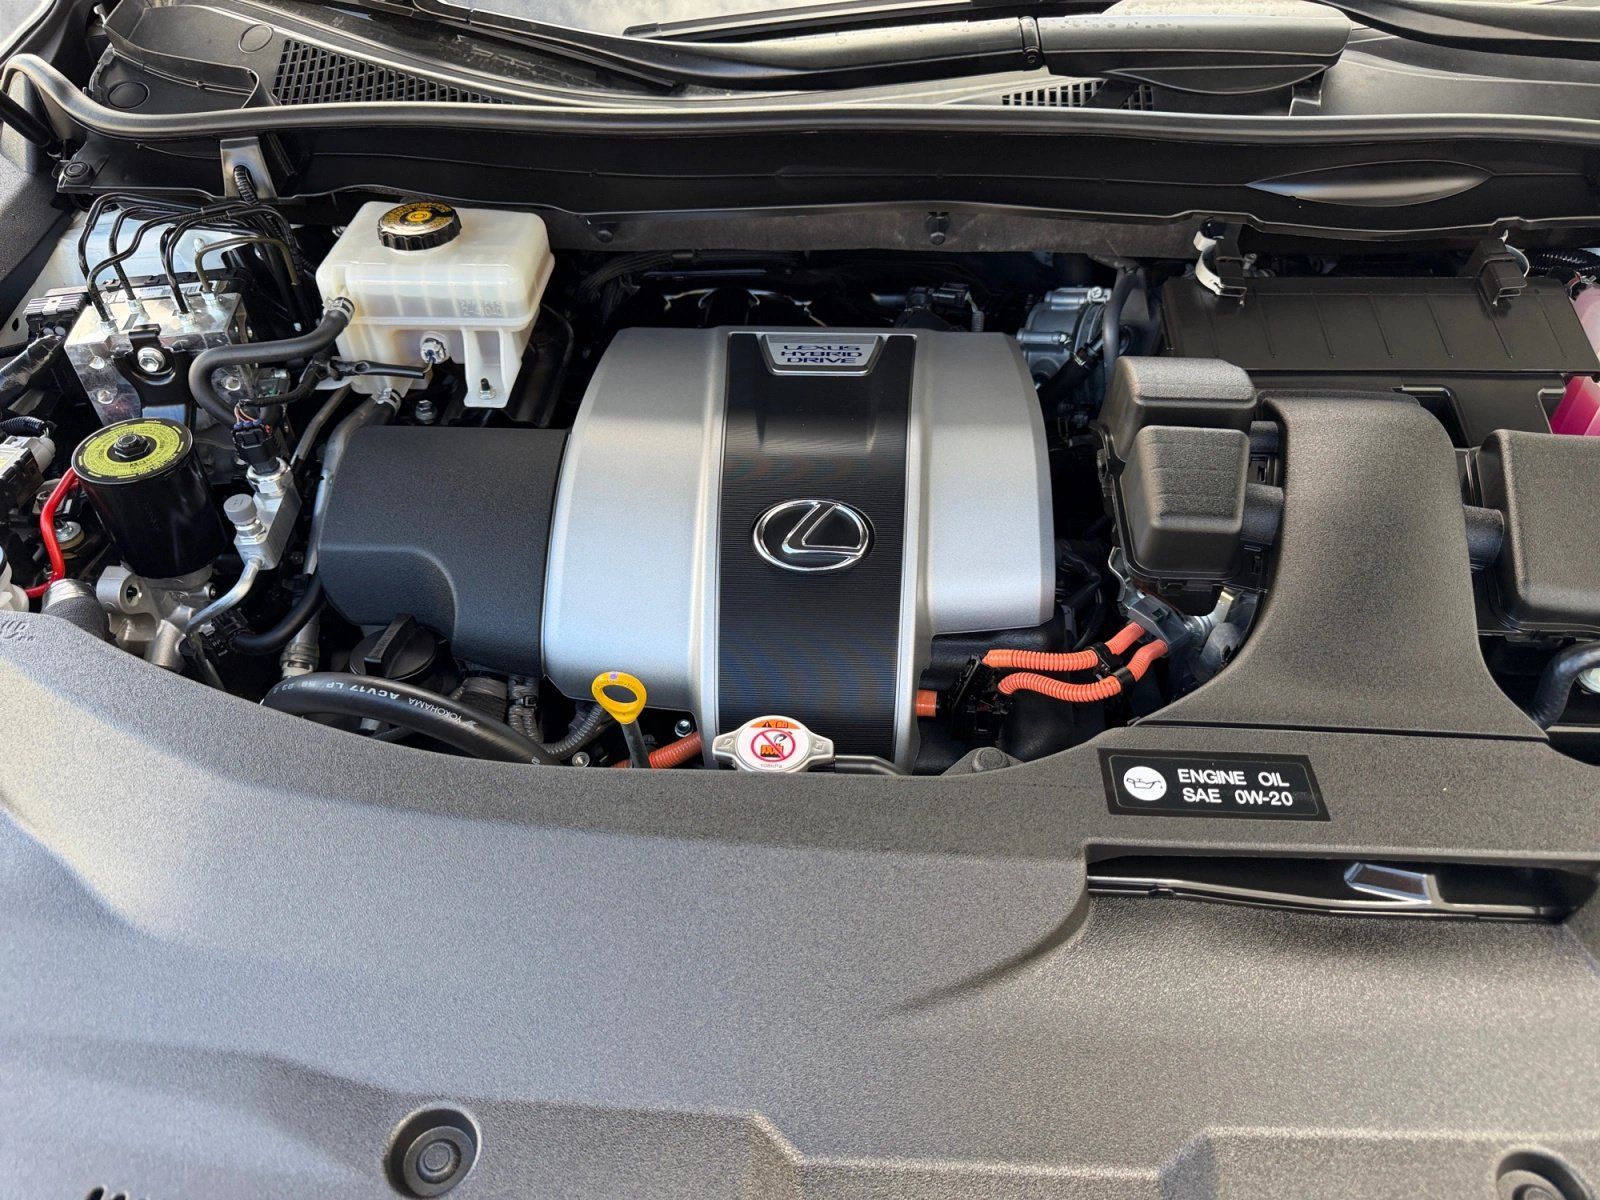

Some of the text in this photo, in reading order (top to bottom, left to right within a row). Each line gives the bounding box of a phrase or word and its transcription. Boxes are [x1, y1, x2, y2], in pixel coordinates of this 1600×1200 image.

[326, 682, 344, 690] LP
[349, 684, 400, 700] ACV17
[408, 697, 462, 725] YOKOHAMA
[1177, 768, 1290, 787] ENGINE OIL
[1182, 787, 1293, 806] SAE 0W-20
